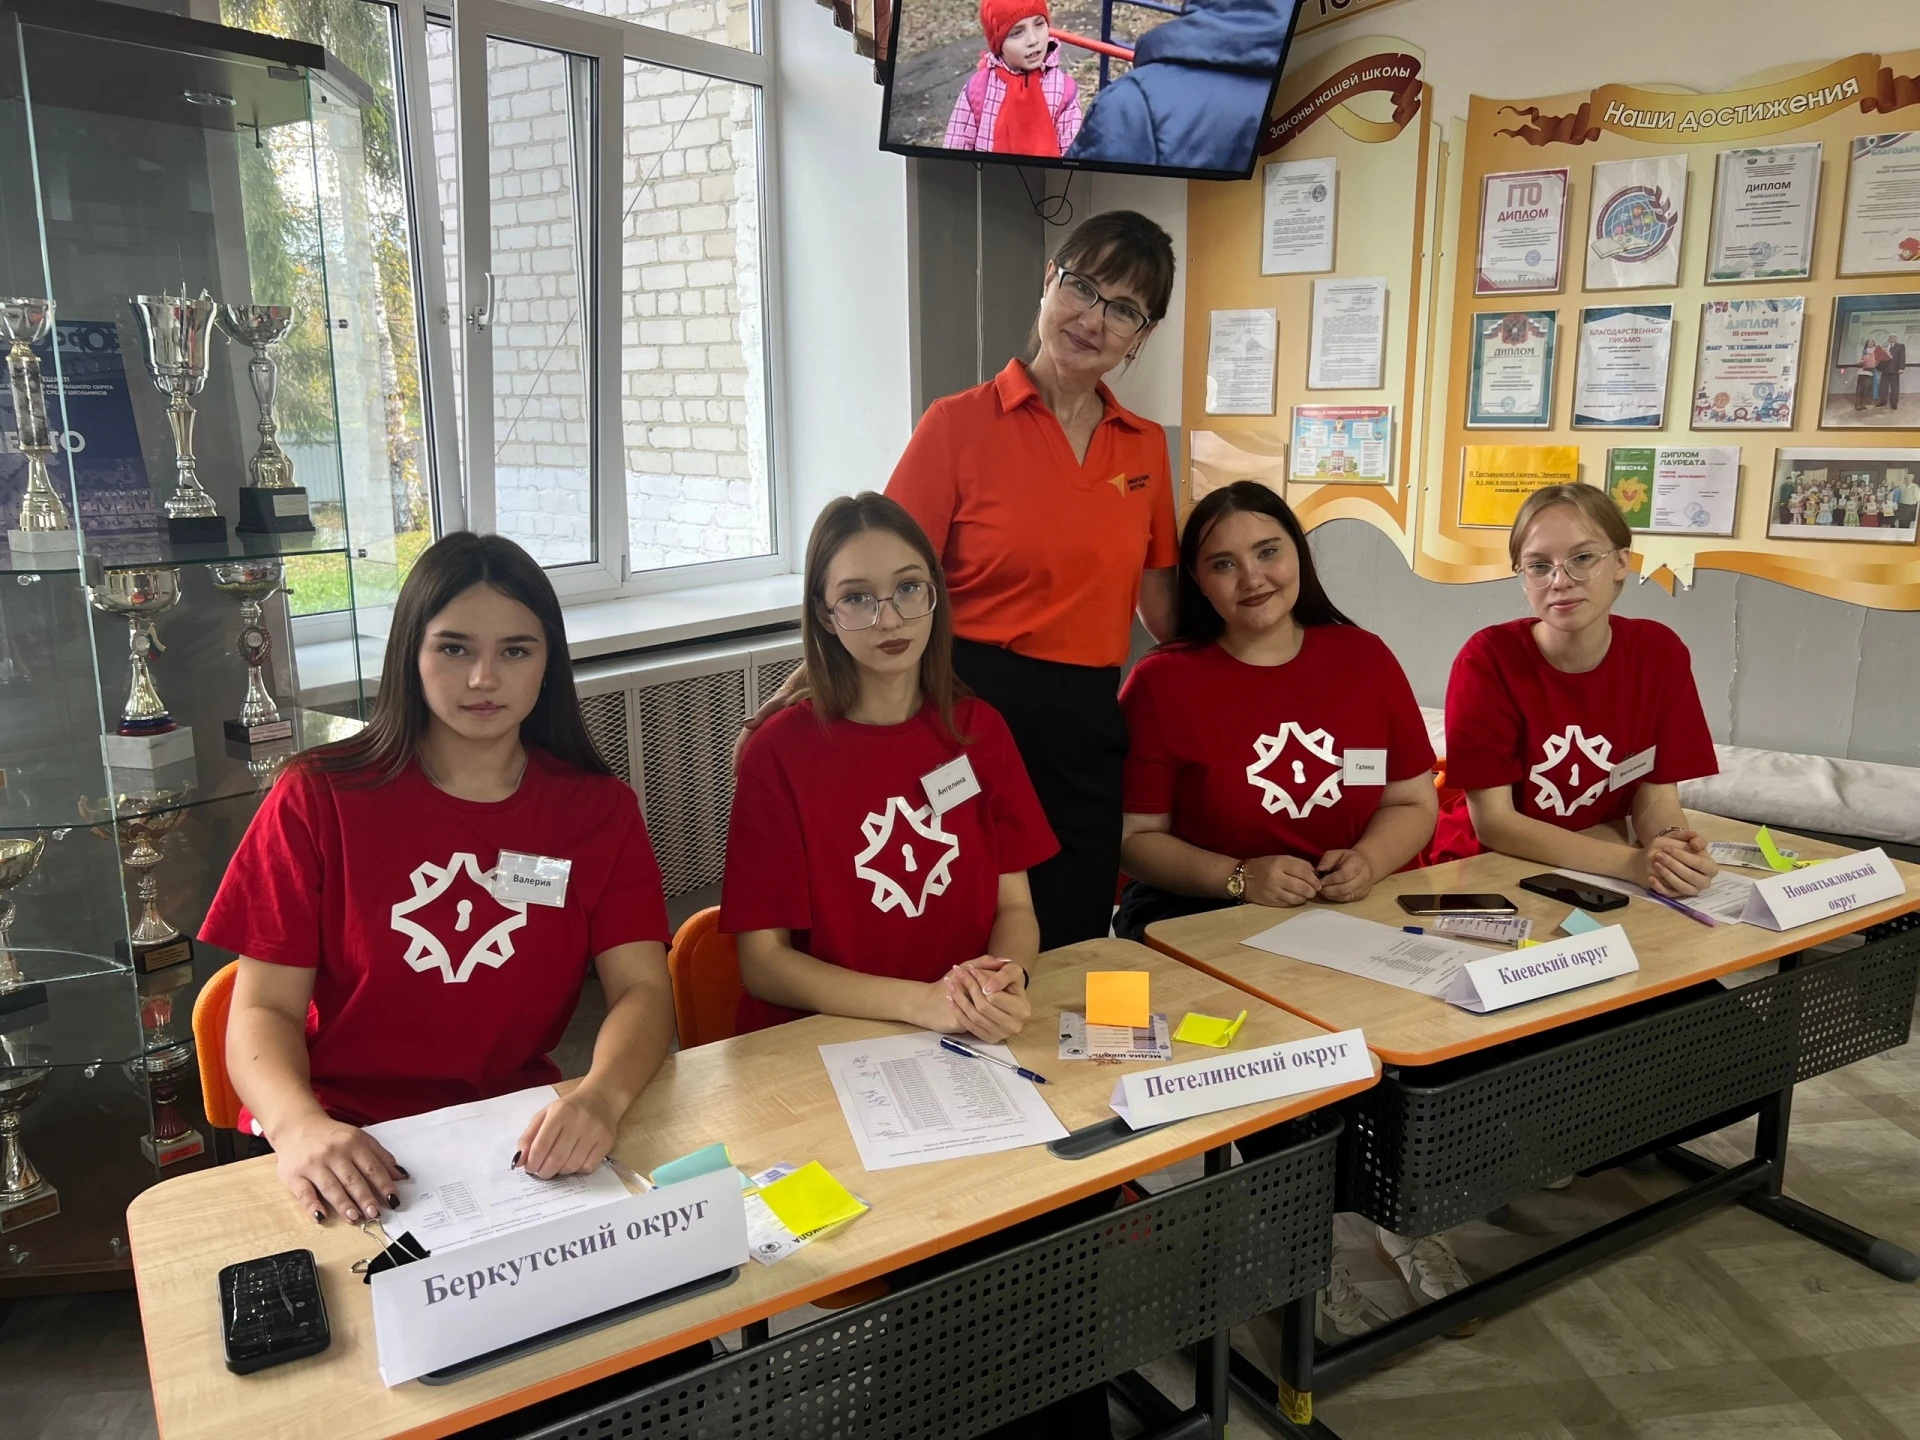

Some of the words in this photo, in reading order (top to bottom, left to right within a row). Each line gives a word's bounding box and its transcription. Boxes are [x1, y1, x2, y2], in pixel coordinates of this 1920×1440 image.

[1269, 102, 1315, 139] Законы
[1315, 72, 1359, 107] нашей
[1362, 66, 1411, 82] школы
[1603, 100, 1675, 129] Наши
[1677, 76, 1860, 132] достижения
[1507, 182, 1543, 207] ГТО
[1745, 181, 1792, 194] ДИПЛОМ
[1497, 208, 1549, 223] ДИПЛОМ
[1589, 327, 1664, 336] БЛАГОДАРСТВЕННОЕ
[1725, 318, 1779, 330] ДИПЛОМ
[1493, 347, 1535, 357] ДИПЛОМ
[1660, 451, 1699, 459] ДИПЛОМ
[937, 776, 967, 796] Ангелина
[512, 874, 552, 887] Валерия
[1781, 863, 1877, 899] Новоатьяловский
[1828, 893, 1857, 911] округ
[1497, 952, 1570, 985] Киевский
[1570, 945, 1608, 967] округ
[1144, 1051, 1287, 1099] Петелинский
[1291, 1042, 1349, 1069] округ
[421, 1222, 618, 1307] Беркутский
[626, 1199, 709, 1241] округ
